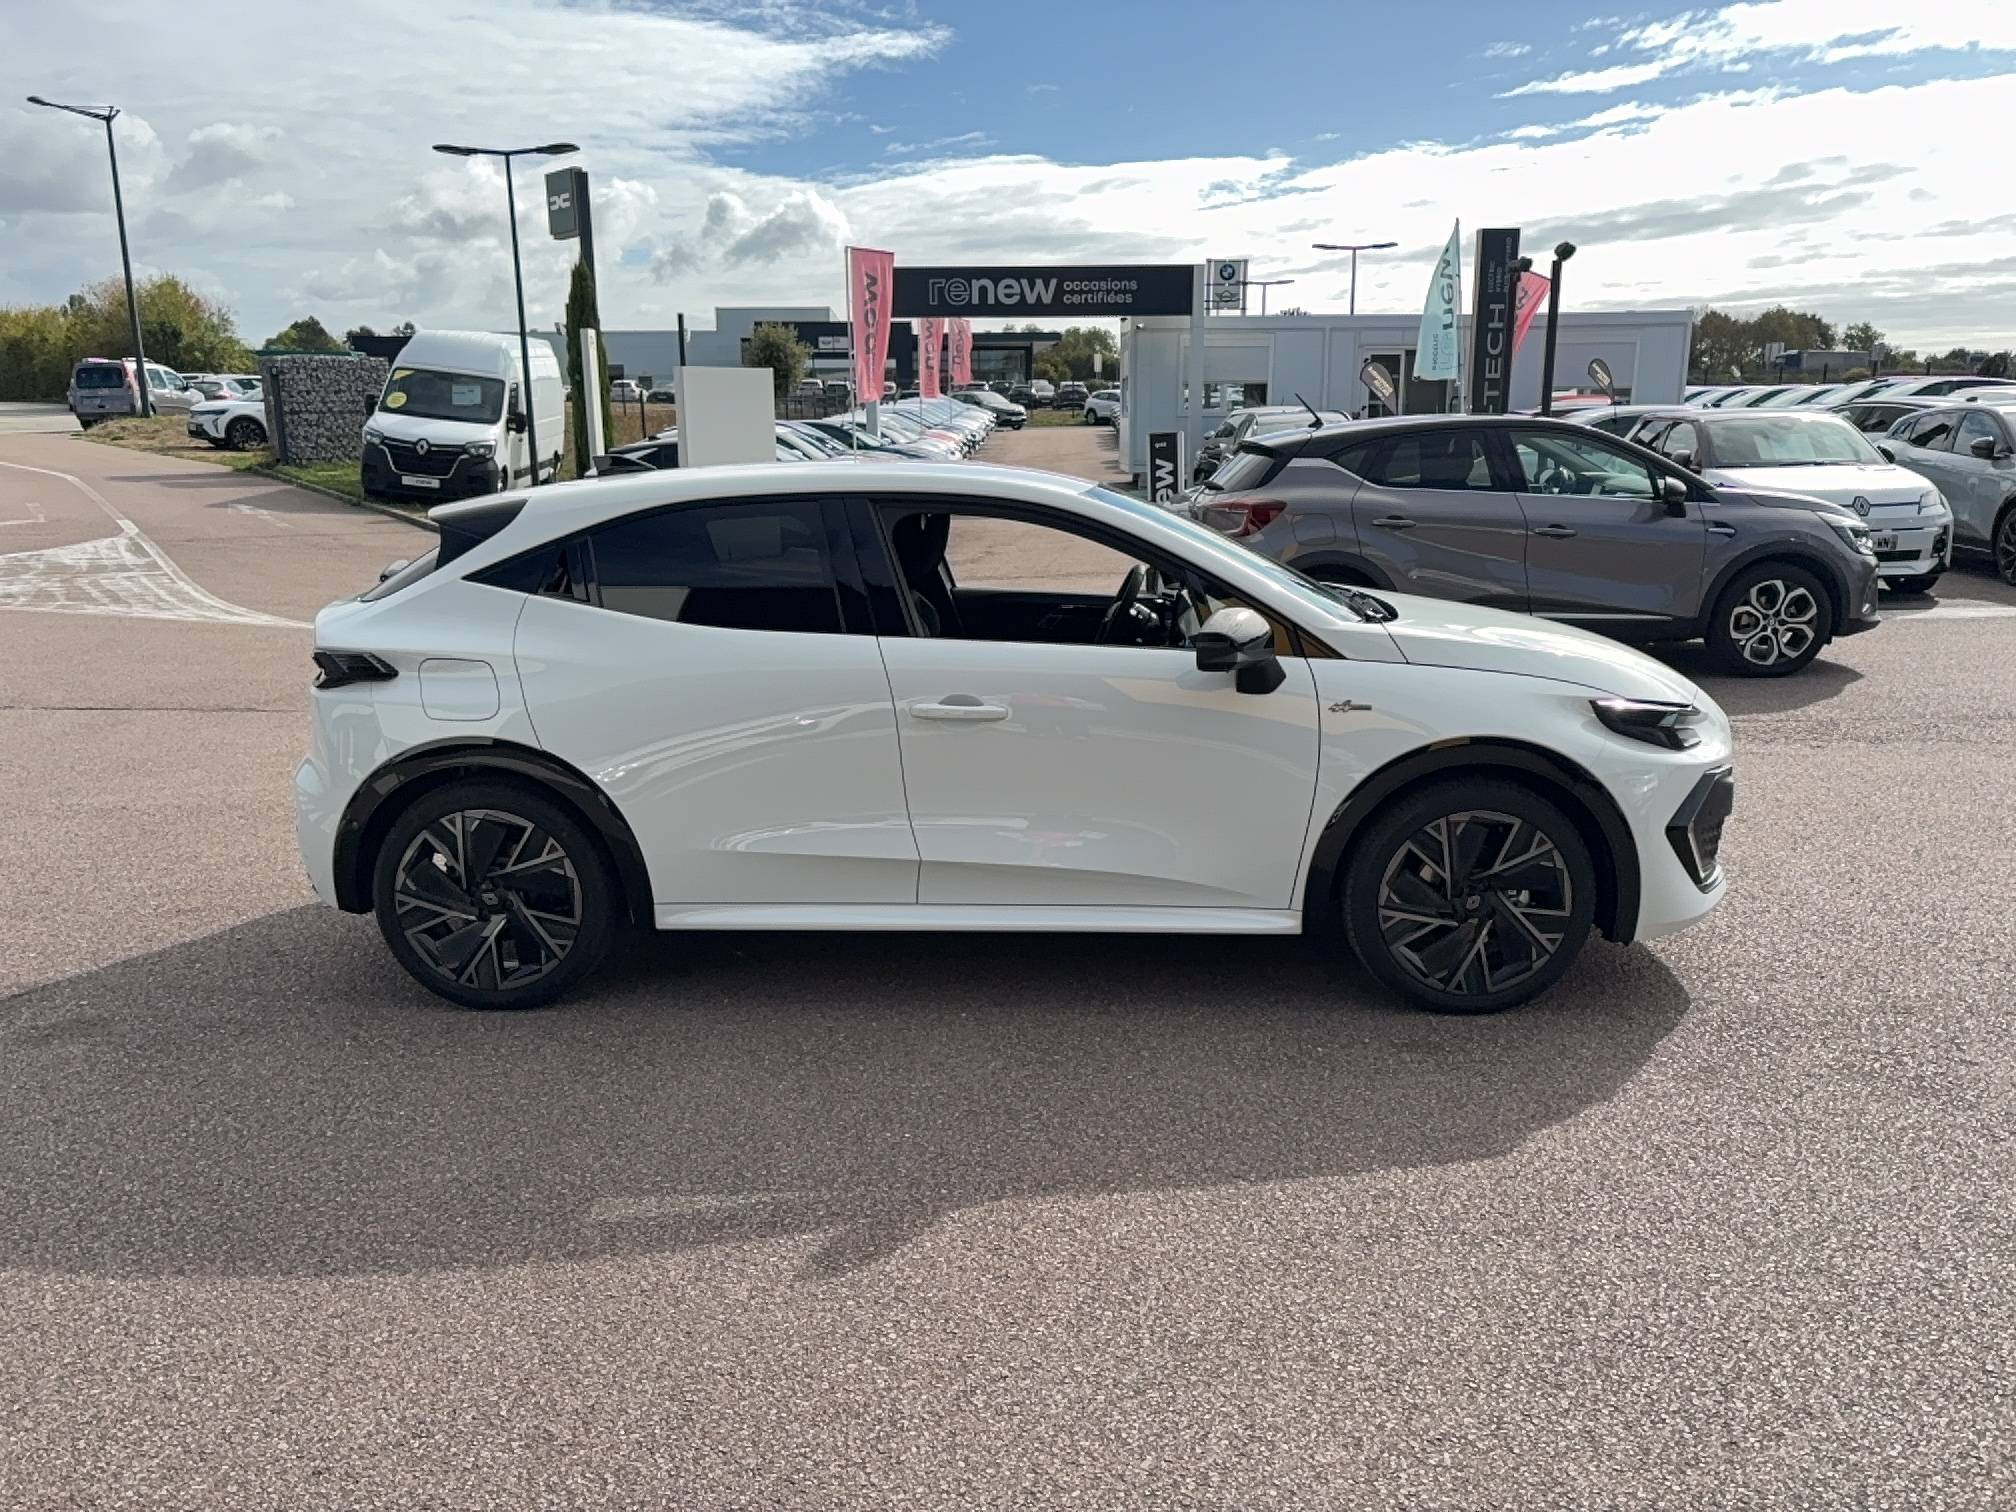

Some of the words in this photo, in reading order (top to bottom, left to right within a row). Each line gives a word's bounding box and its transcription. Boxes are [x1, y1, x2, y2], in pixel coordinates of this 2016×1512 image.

[1063, 277, 1139, 290] occasions
[928, 277, 1059, 305] renew
[1063, 291, 1134, 304] certifiées
